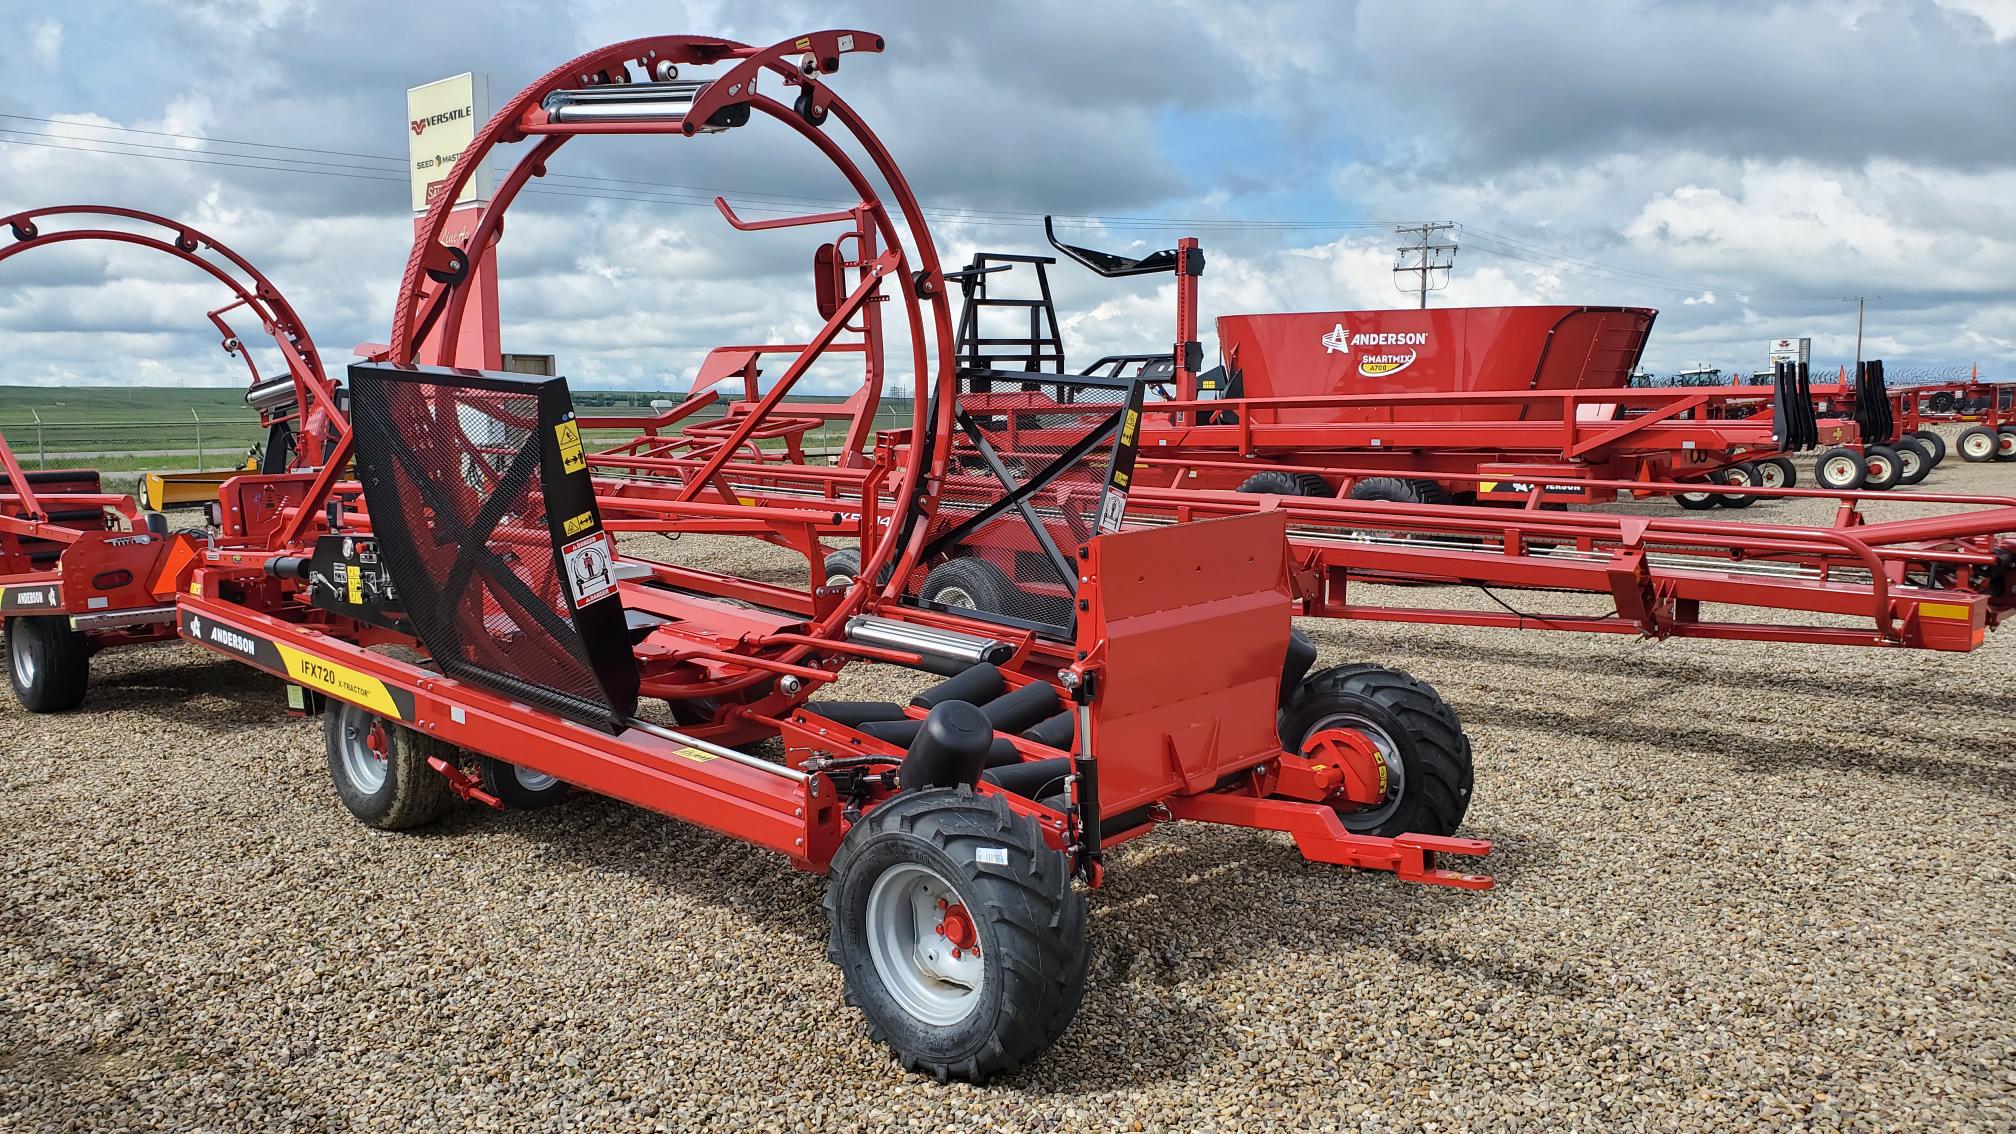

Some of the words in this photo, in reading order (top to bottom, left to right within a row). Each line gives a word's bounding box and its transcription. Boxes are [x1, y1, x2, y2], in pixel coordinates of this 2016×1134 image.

[426, 106, 471, 127] VERSATILE
[417, 159, 434, 170] SEED
[1350, 333, 1427, 346] ANDERSON
[1362, 355, 1410, 364] SMARTMIX
[576, 536, 597, 548] DANGER
[17, 591, 44, 605] ANDERSON
[589, 588, 610, 600] DANGER
[210, 626, 255, 656] ANDERSON
[301, 659, 335, 684] IFX720
